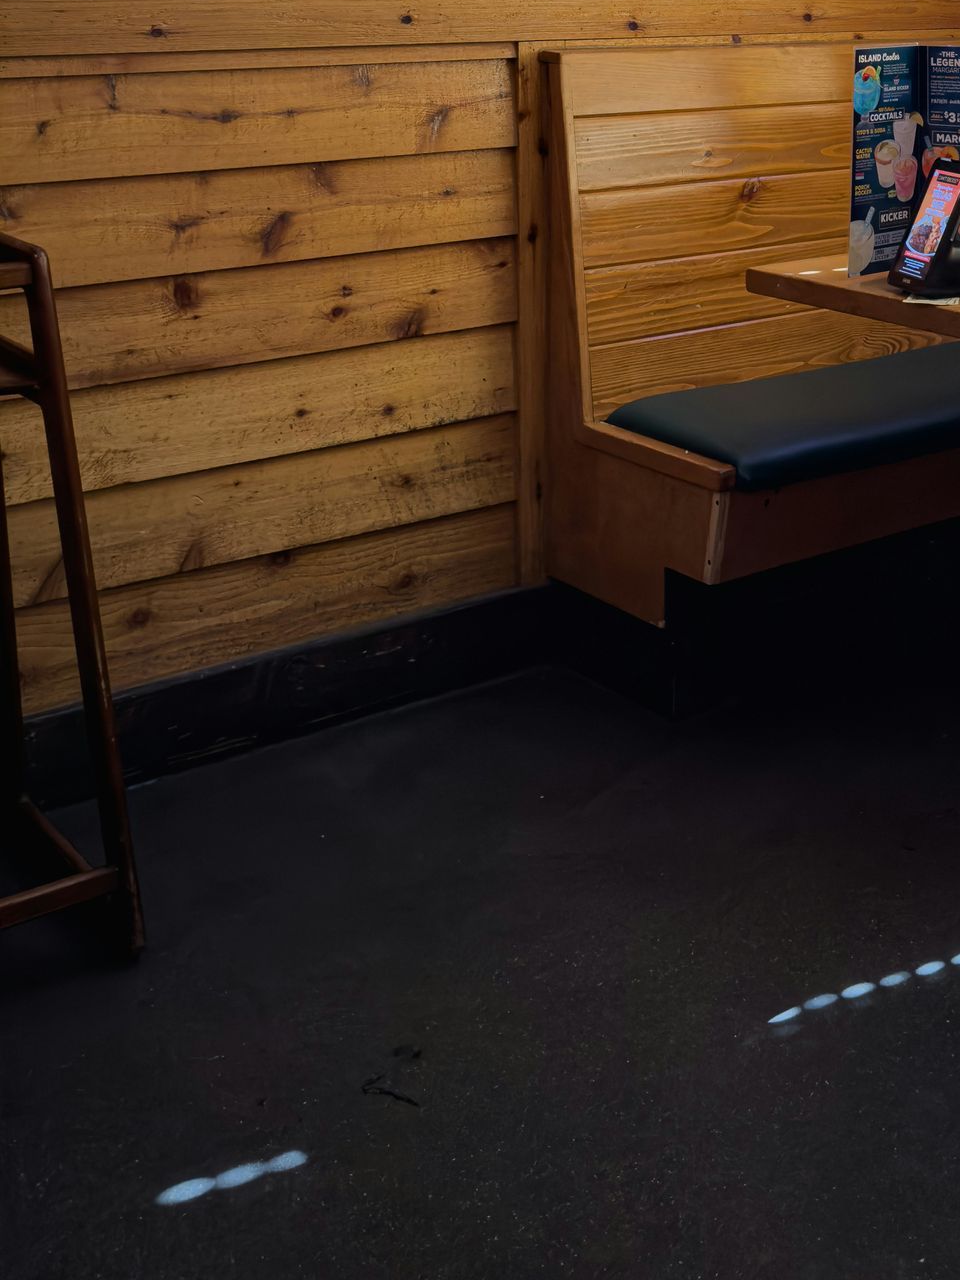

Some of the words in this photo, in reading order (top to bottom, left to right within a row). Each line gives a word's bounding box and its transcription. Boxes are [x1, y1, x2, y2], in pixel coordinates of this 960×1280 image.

[859, 54, 881, 63] ISLAND
[882, 52, 900, 62] Cooler
[870, 111, 903, 122] COCKTAILS
[944, 110, 956, 123] $3
[880, 211, 908, 223] KICKER
